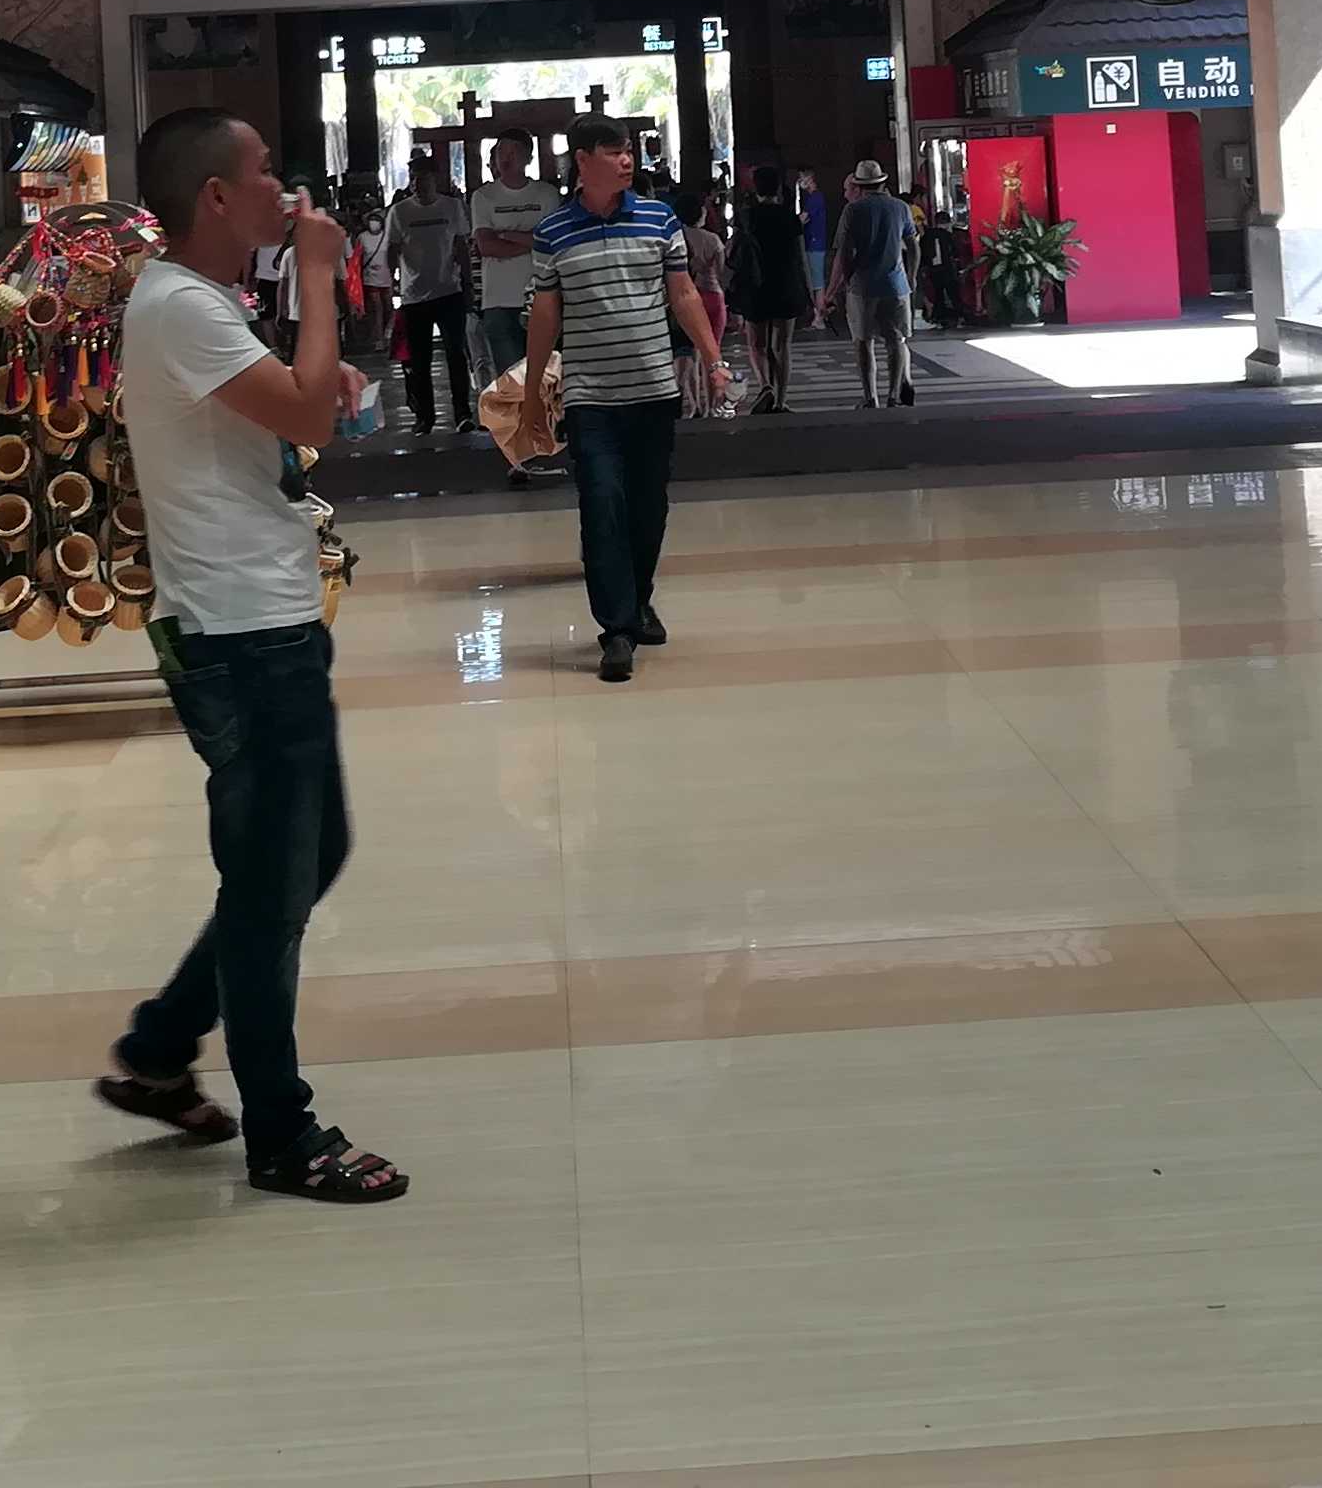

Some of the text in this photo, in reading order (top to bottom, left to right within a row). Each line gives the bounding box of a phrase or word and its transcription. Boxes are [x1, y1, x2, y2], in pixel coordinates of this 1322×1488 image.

[377, 54, 419, 67] TICKETS
[1157, 55, 1237, 87] 自动
[1163, 85, 1240, 100] VENDING
